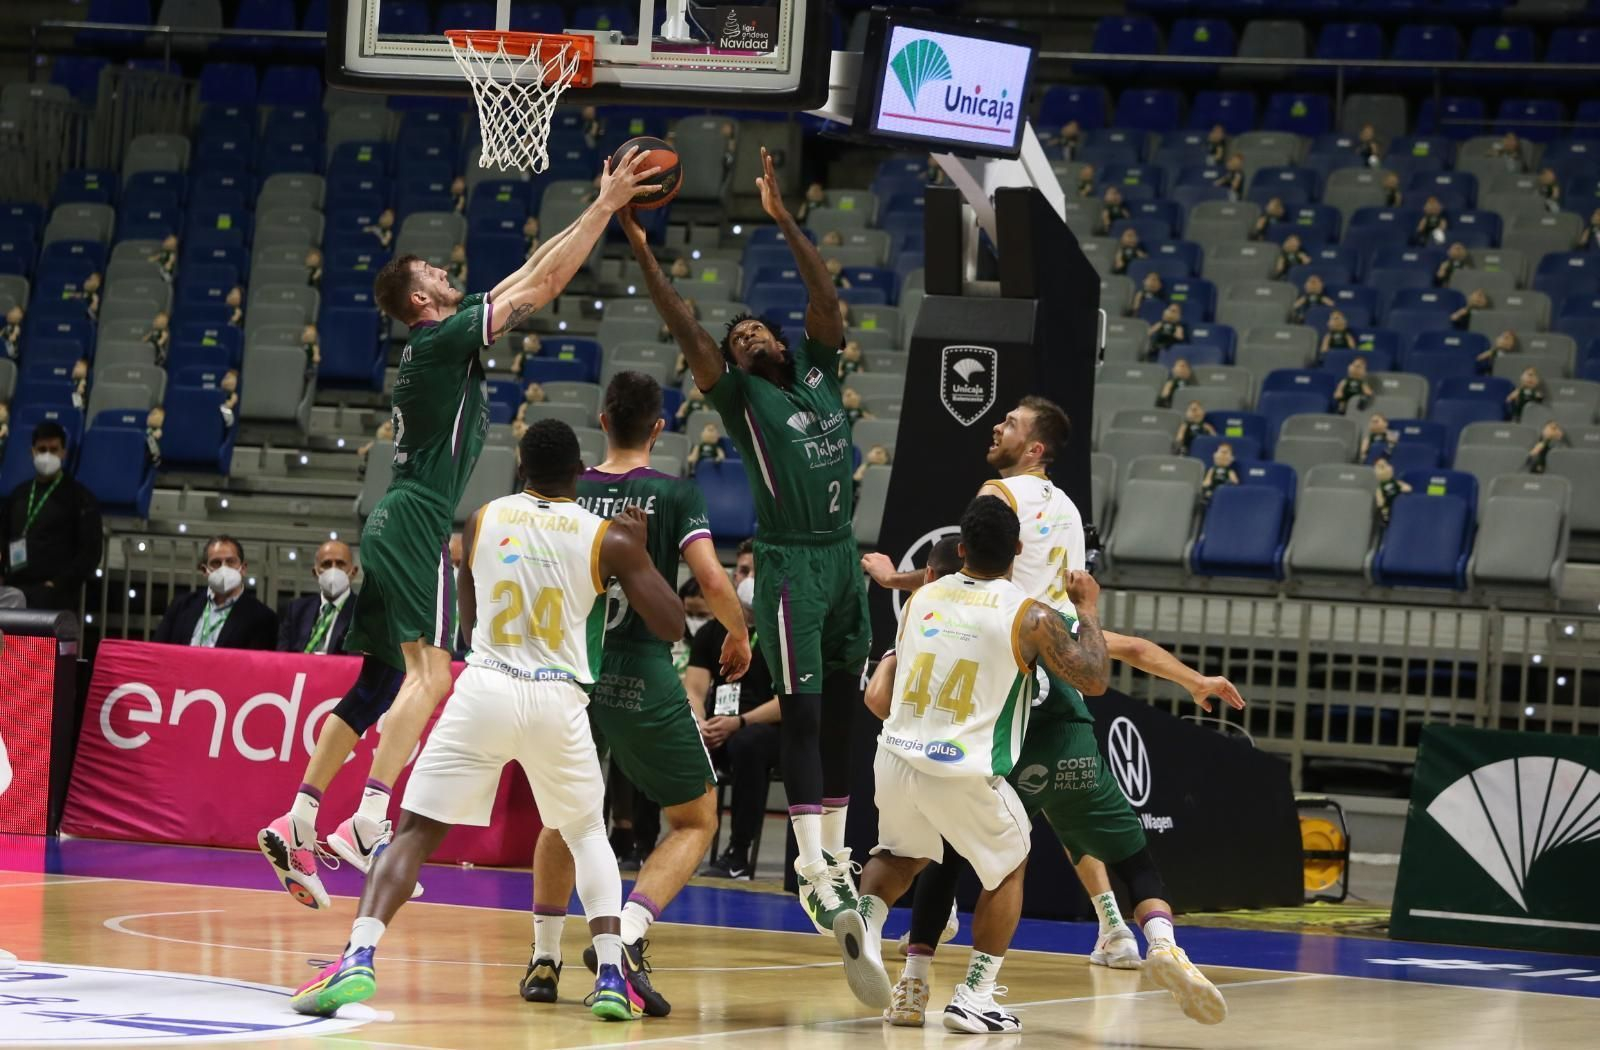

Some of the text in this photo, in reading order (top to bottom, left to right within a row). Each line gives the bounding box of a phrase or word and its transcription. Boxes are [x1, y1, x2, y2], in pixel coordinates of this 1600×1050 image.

[720, 38, 768, 49] Navidad
[944, 84, 1014, 126] Unicaja
[952, 384, 984, 395] Unicaja
[820, 408, 846, 431] Unica
[828, 480, 841, 513] 2
[489, 579, 565, 653] 24
[600, 673, 646, 691] COSTA
[902, 652, 979, 725] 44
[619, 689, 644, 702] SOL
[100, 672, 420, 768] ende
[928, 743, 958, 756] plus
[1056, 757, 1097, 770] COSTA
[1055, 771, 1079, 781] DEL
[1141, 813, 1174, 833] Wagen
